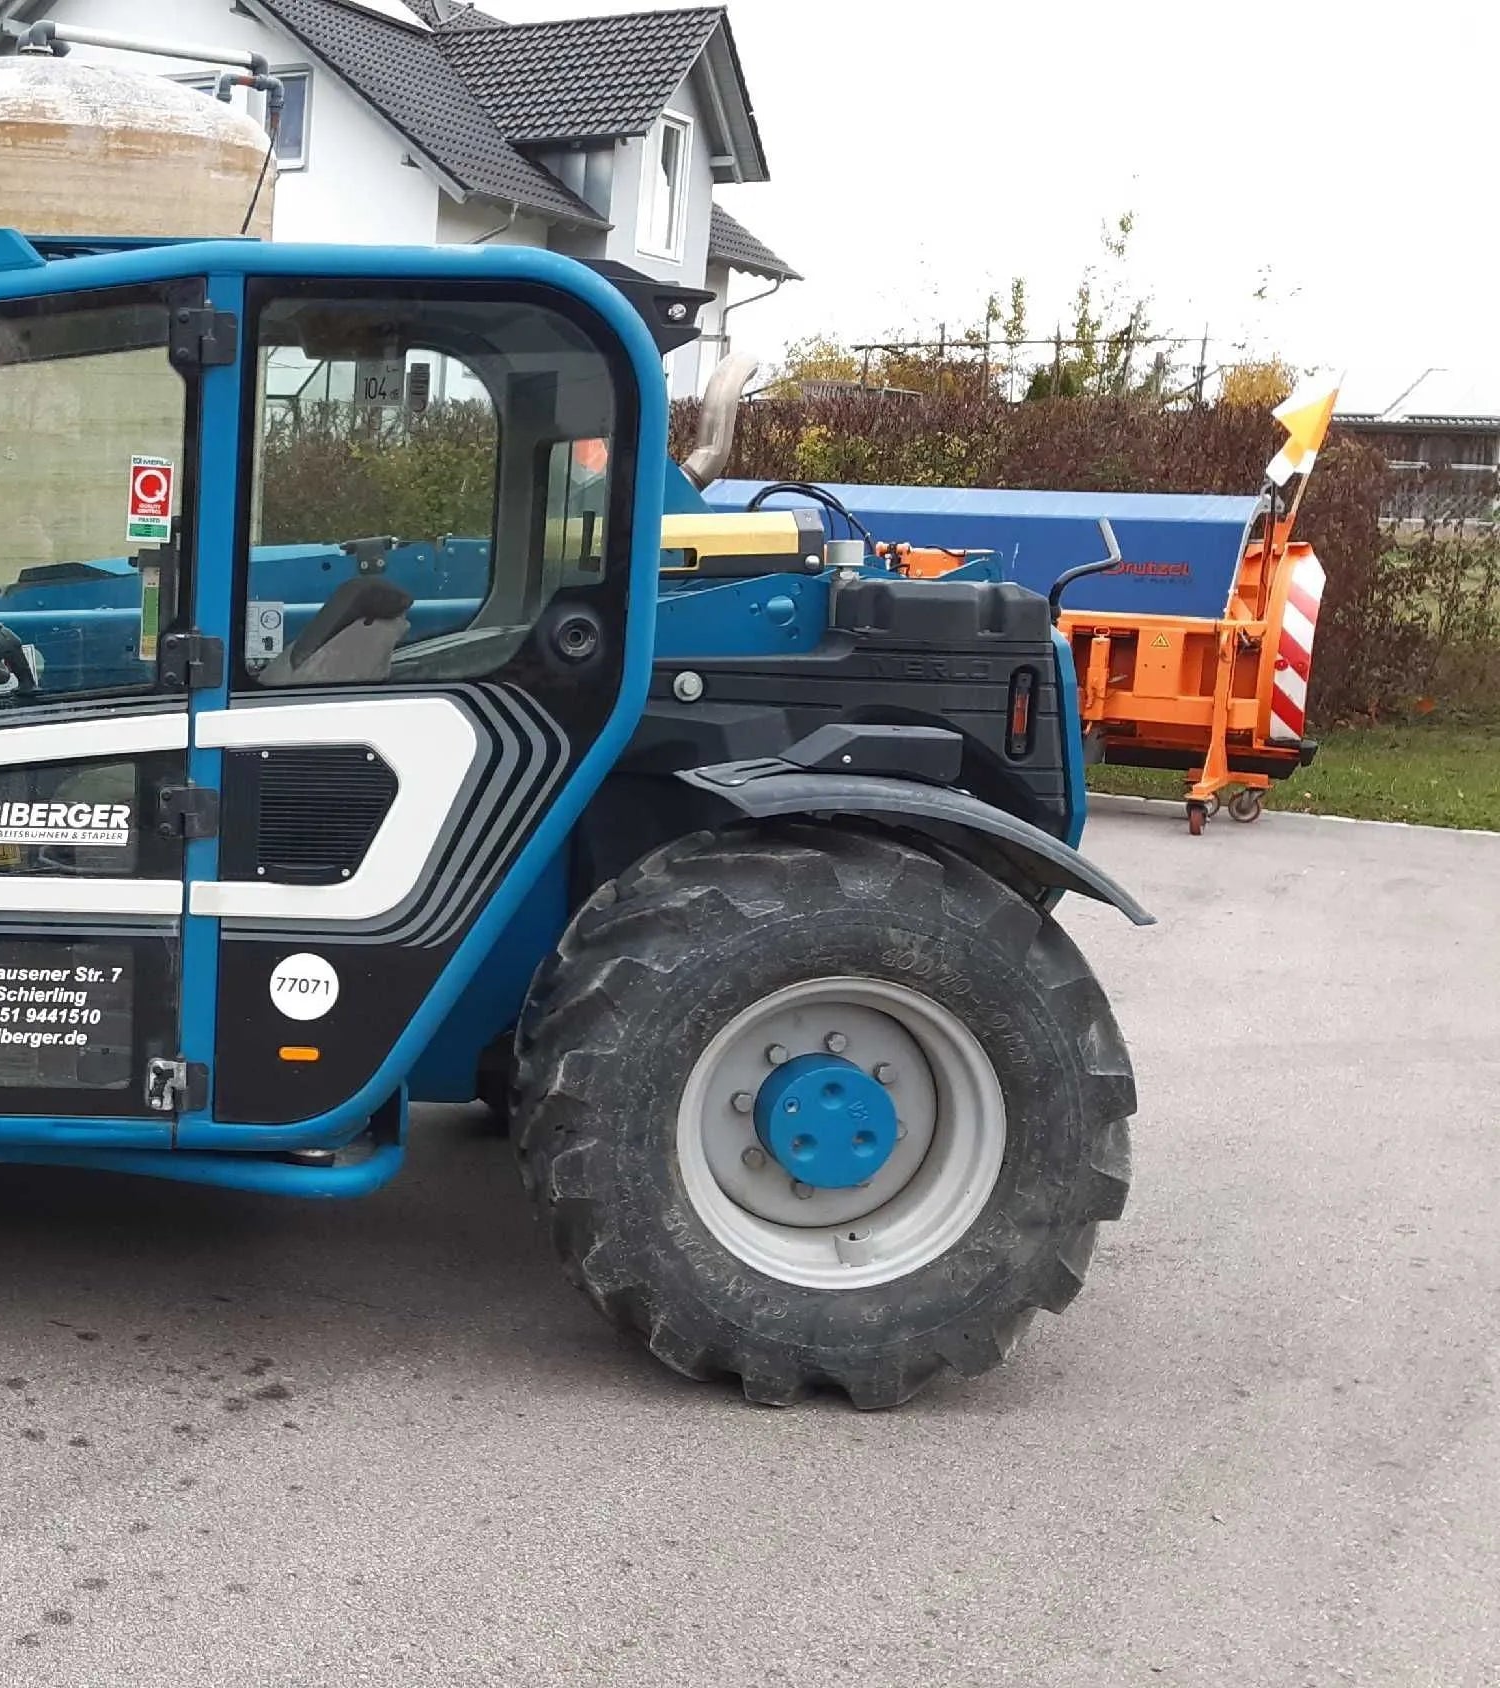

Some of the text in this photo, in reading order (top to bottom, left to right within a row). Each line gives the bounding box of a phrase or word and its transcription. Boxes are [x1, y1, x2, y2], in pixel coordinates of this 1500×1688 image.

[363, 376, 387, 400] 104
[134, 469, 167, 504] Q
[71, 831, 79, 840] &
[80, 831, 124, 840] STAPLER
[74, 966, 105, 983] Str.
[111, 967, 123, 983] 7
[276, 976, 330, 996] 77071
[25, 1009, 101, 1025] 9441510
